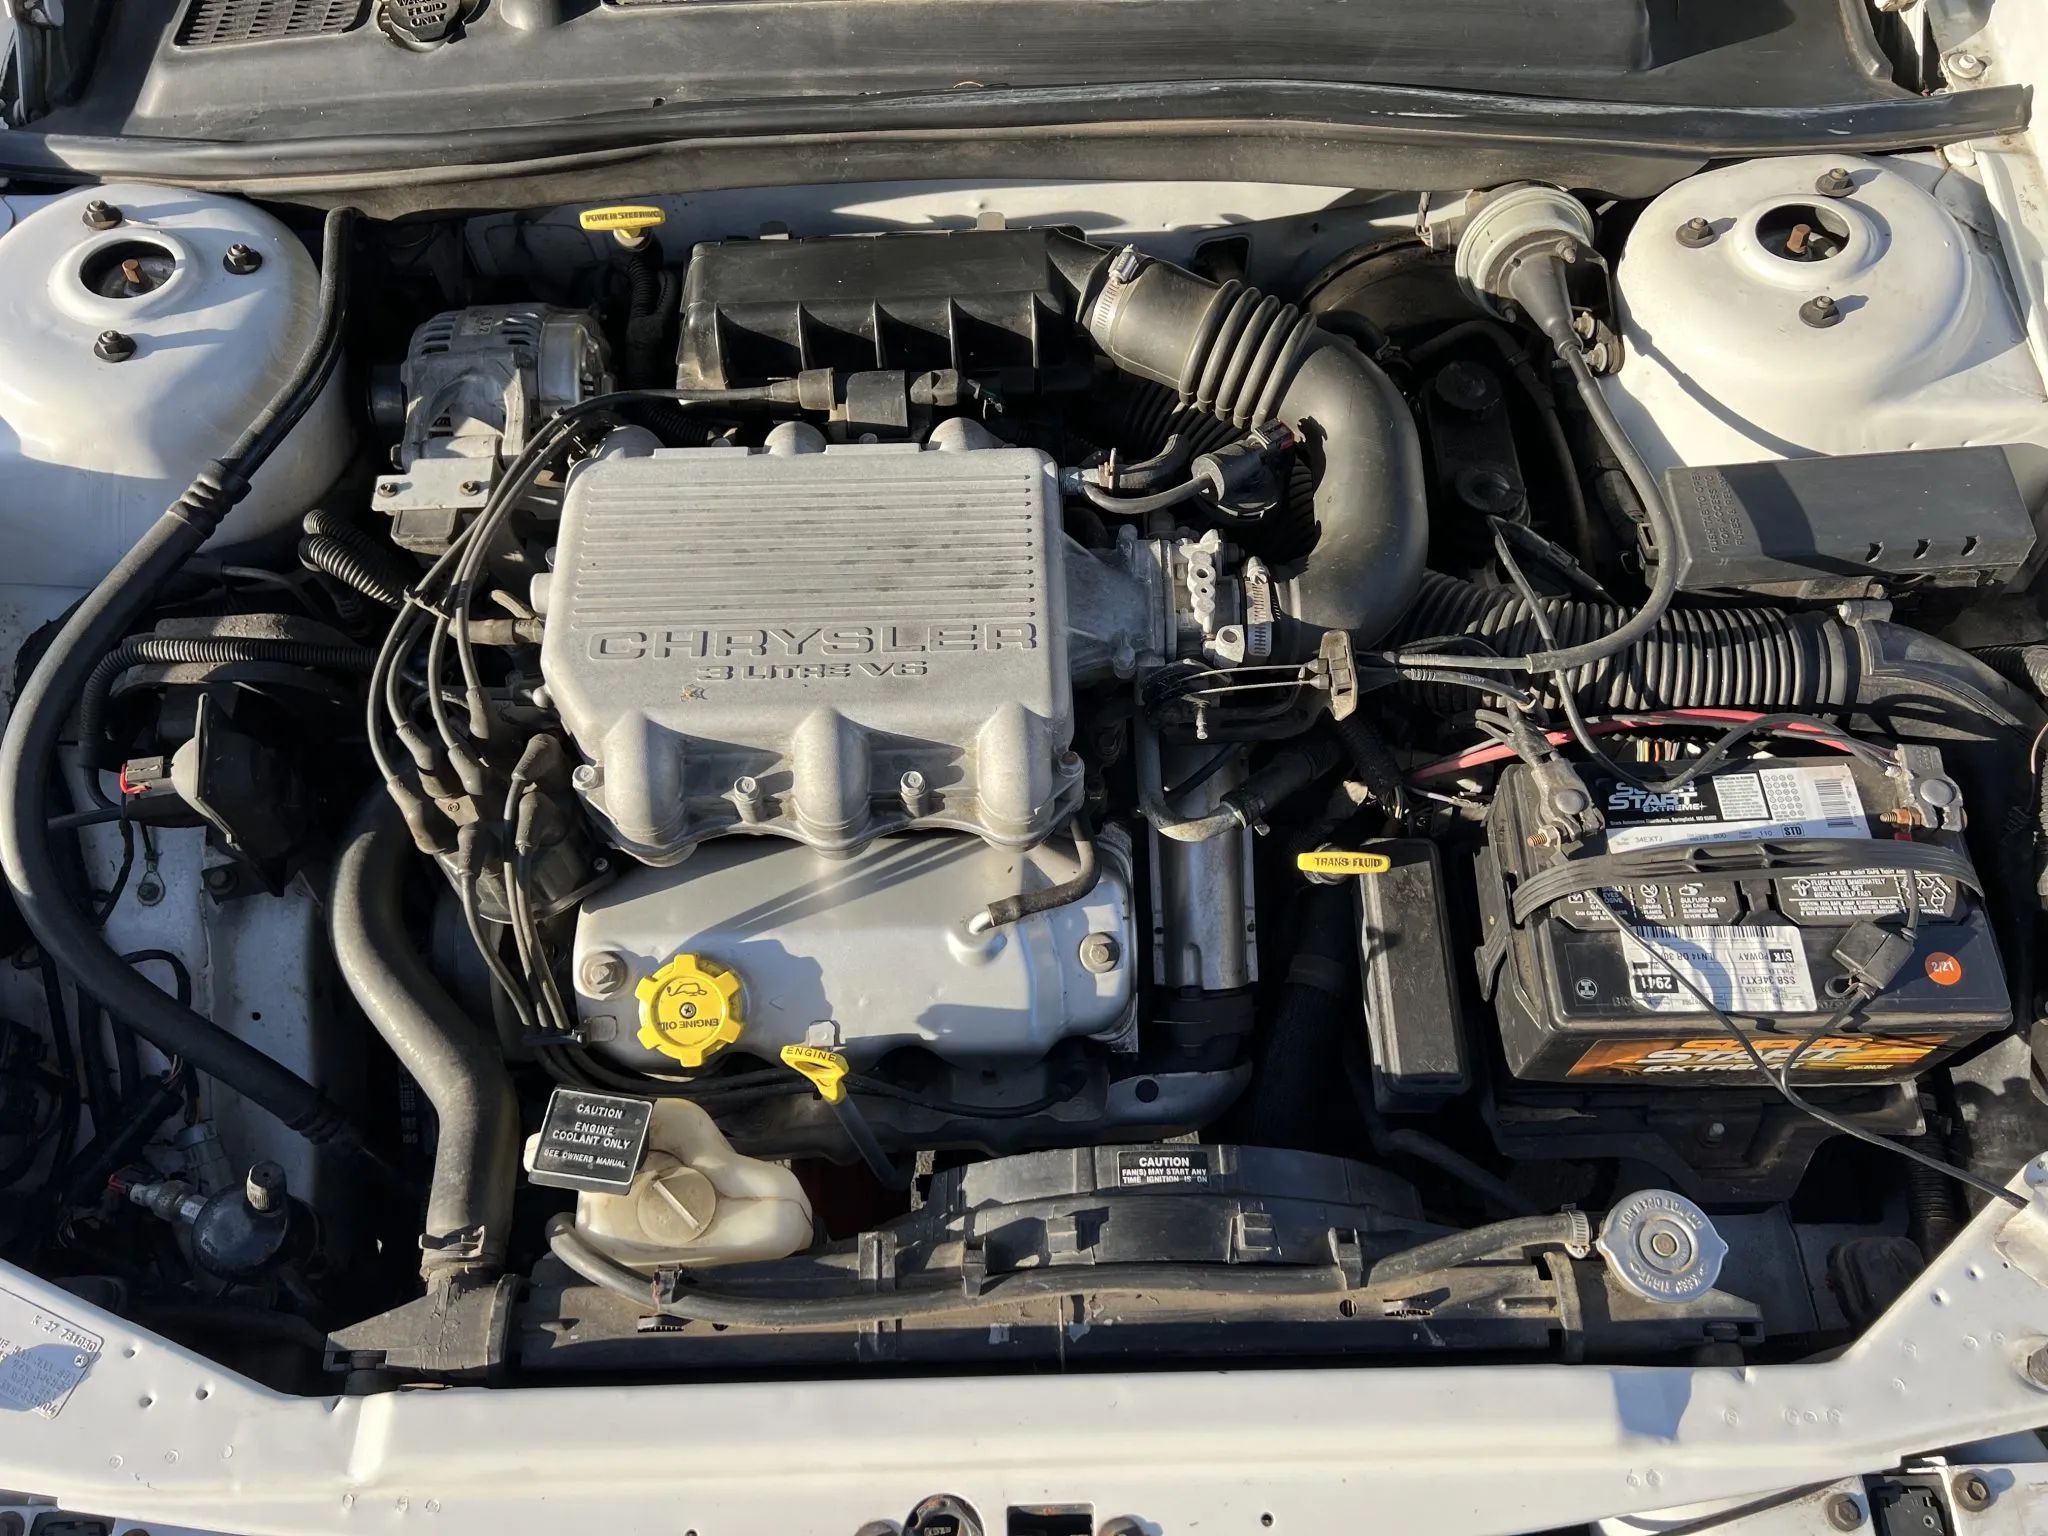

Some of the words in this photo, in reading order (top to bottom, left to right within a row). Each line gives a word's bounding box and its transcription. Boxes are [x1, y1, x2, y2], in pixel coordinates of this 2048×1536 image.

[407, 2, 447, 17] FLUID
[410, 13, 446, 27] ONLY
[585, 212, 617, 223] POWER
[618, 210, 660, 219] STEERING
[586, 622, 1038, 661] CHRYSLER
[696, 665, 734, 681] 3
[742, 662, 851, 681] LITRE
[857, 660, 929, 677] V6
[1608, 791, 1698, 811] START
[1643, 803, 1700, 812] EXTREME
[1783, 826, 1802, 836] STD
[1314, 857, 1350, 867] TRANS
[1352, 857, 1383, 868] FLUID
[1773, 952, 1793, 962] STK
[1931, 960, 1954, 973] 2/21
[1641, 976, 1673, 989] 2941
[659, 1020, 678, 1032] OIL
[679, 1018, 720, 1029] ENGINE
[786, 1046, 837, 1063] ENGINE
[576, 1103, 623, 1119] CAUTION
[574, 1121, 615, 1137] ENGINE
[552, 1129, 600, 1146] COOLANT
[603, 1138, 631, 1150] ONLY
[544, 1148, 560, 1158] SEE
[562, 1151, 594, 1163] OWNERS
[595, 1156, 626, 1168] MANUAL
[1138, 1156, 1190, 1168] CAUTION
[1121, 1168, 1147, 1177] FAN(S)
[1147, 1168, 1164, 1176] MAY
[1166, 1168, 1189, 1176] START
[1191, 1168, 1207, 1176] ANY
[1122, 1176, 1141, 1184] TIME
[1146, 1175, 1179, 1183] IGNITION
[1183, 1175, 1192, 1183] IS
[41, 1320, 60, 1334] 27
